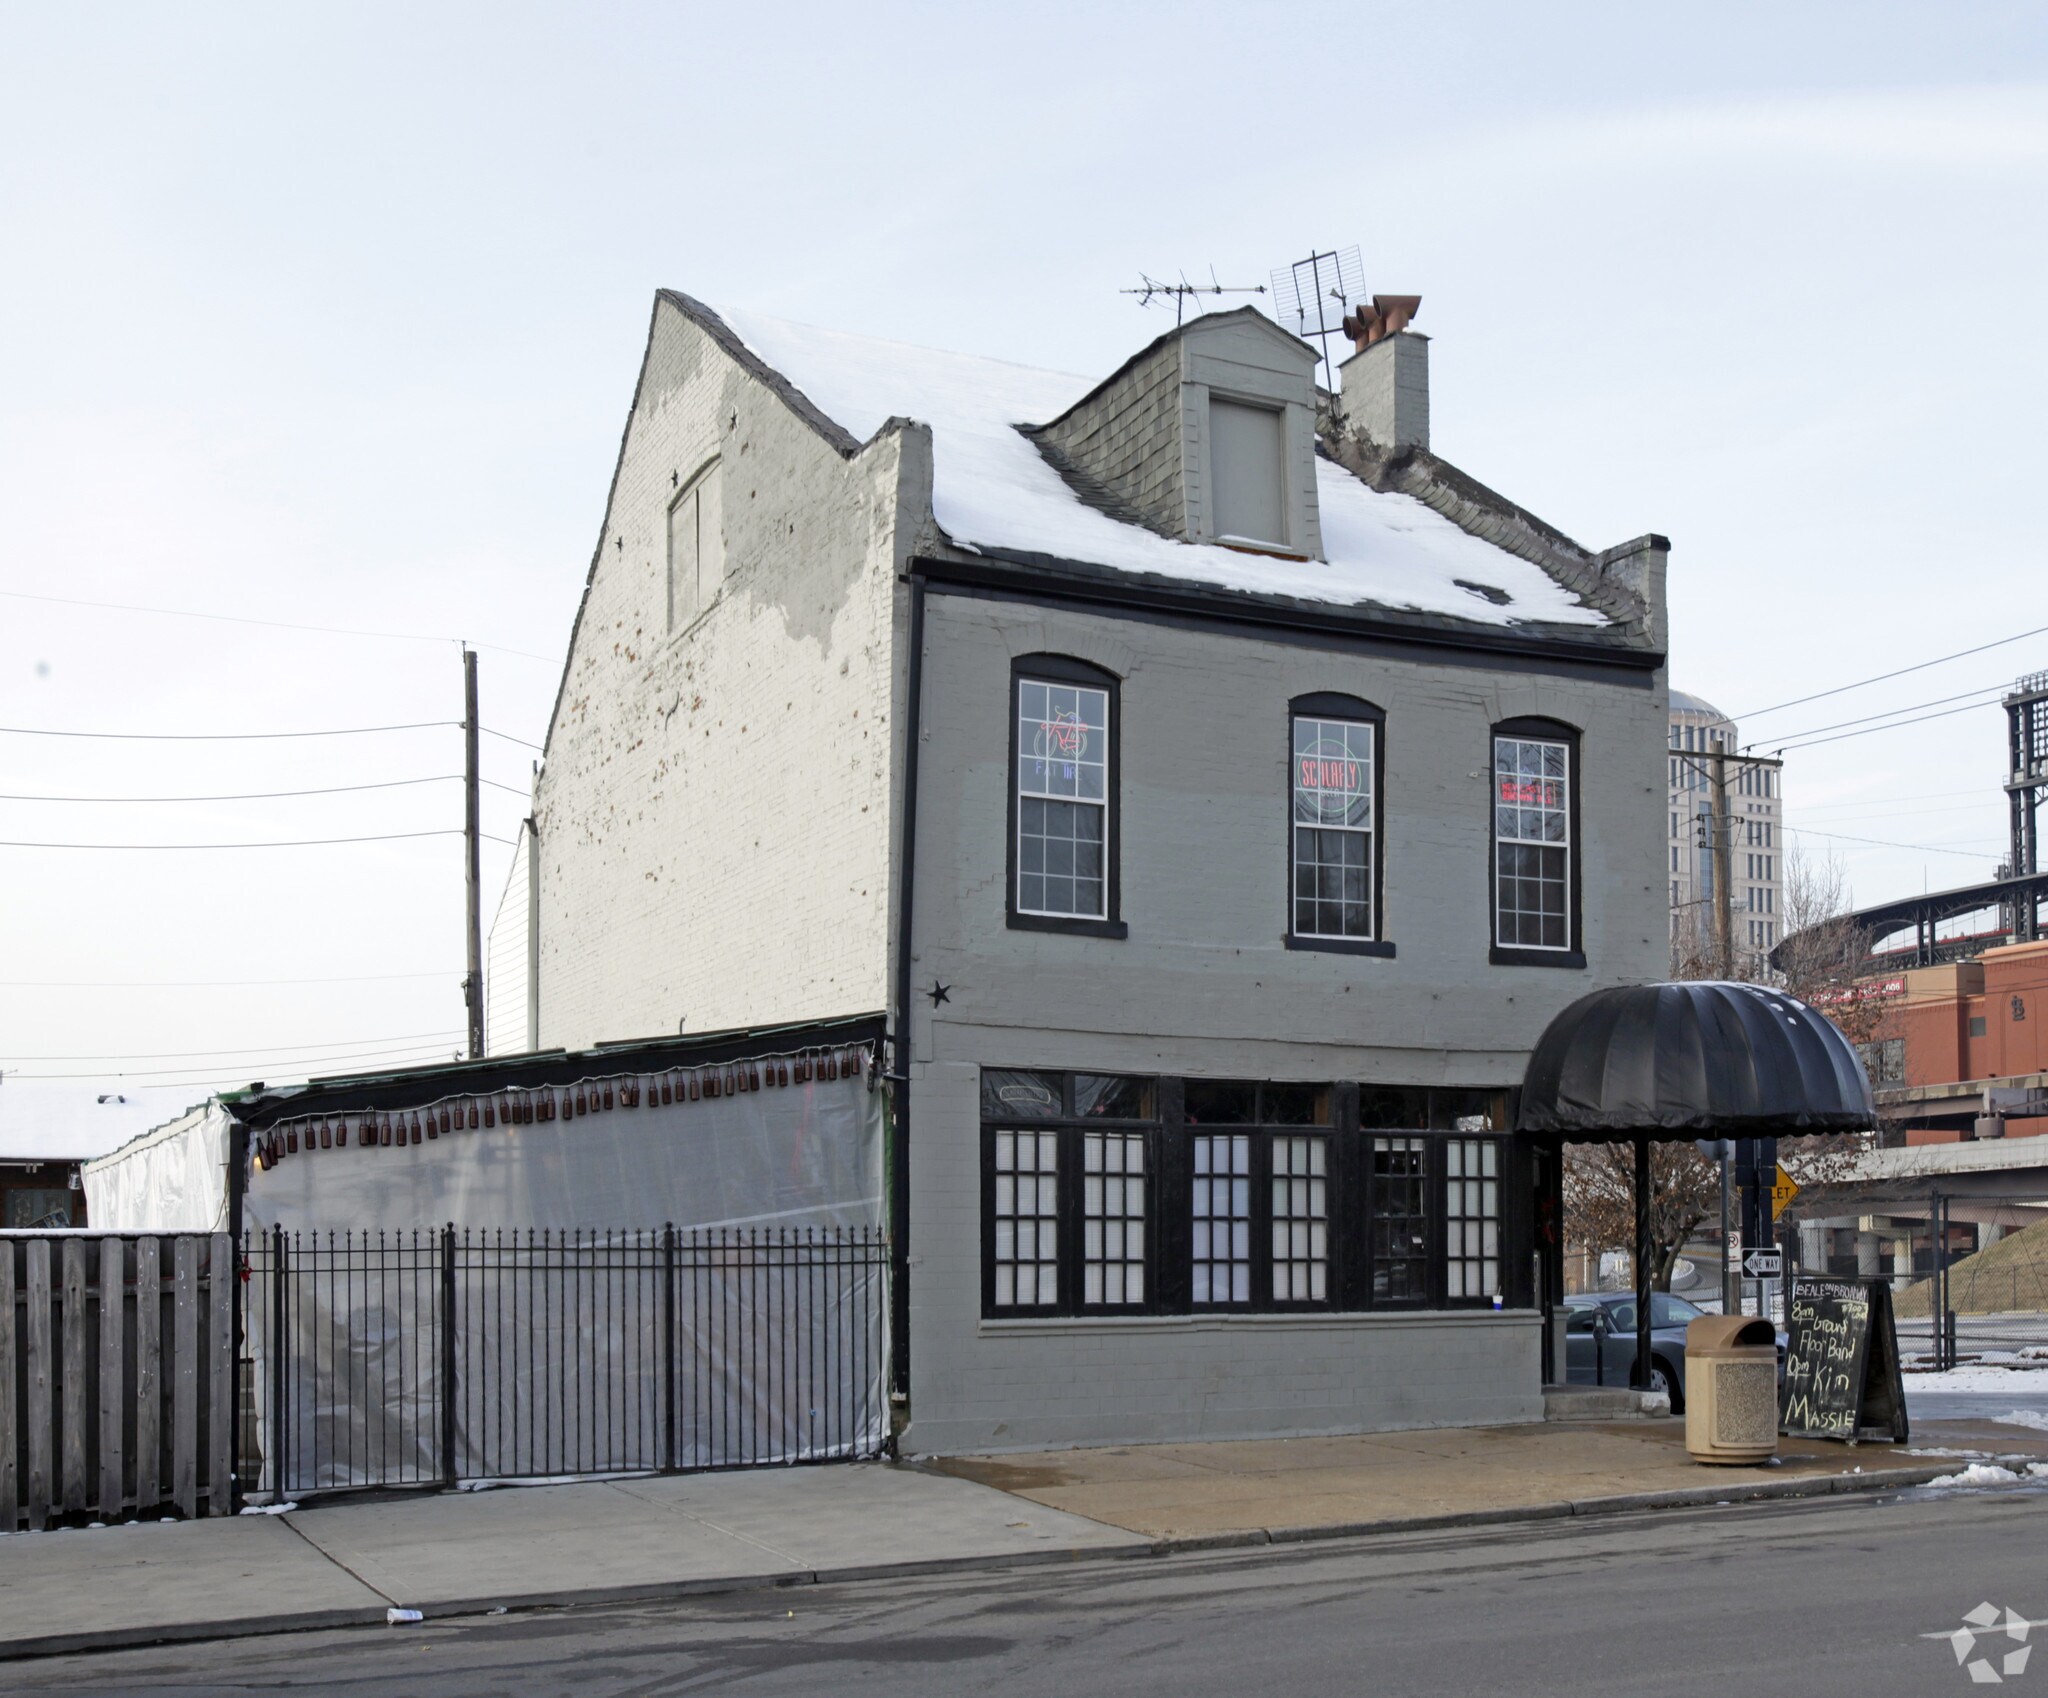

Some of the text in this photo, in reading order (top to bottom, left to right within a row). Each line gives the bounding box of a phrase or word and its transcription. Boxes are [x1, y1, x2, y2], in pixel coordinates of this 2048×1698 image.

[1035, 760, 1057, 776] FAT
[1750, 1258, 1762, 1270] ONE
[1765, 1258, 1778, 1270] WAY
[1796, 1284, 1824, 1297] BEALE
[1828, 1337, 1855, 1360] Band
